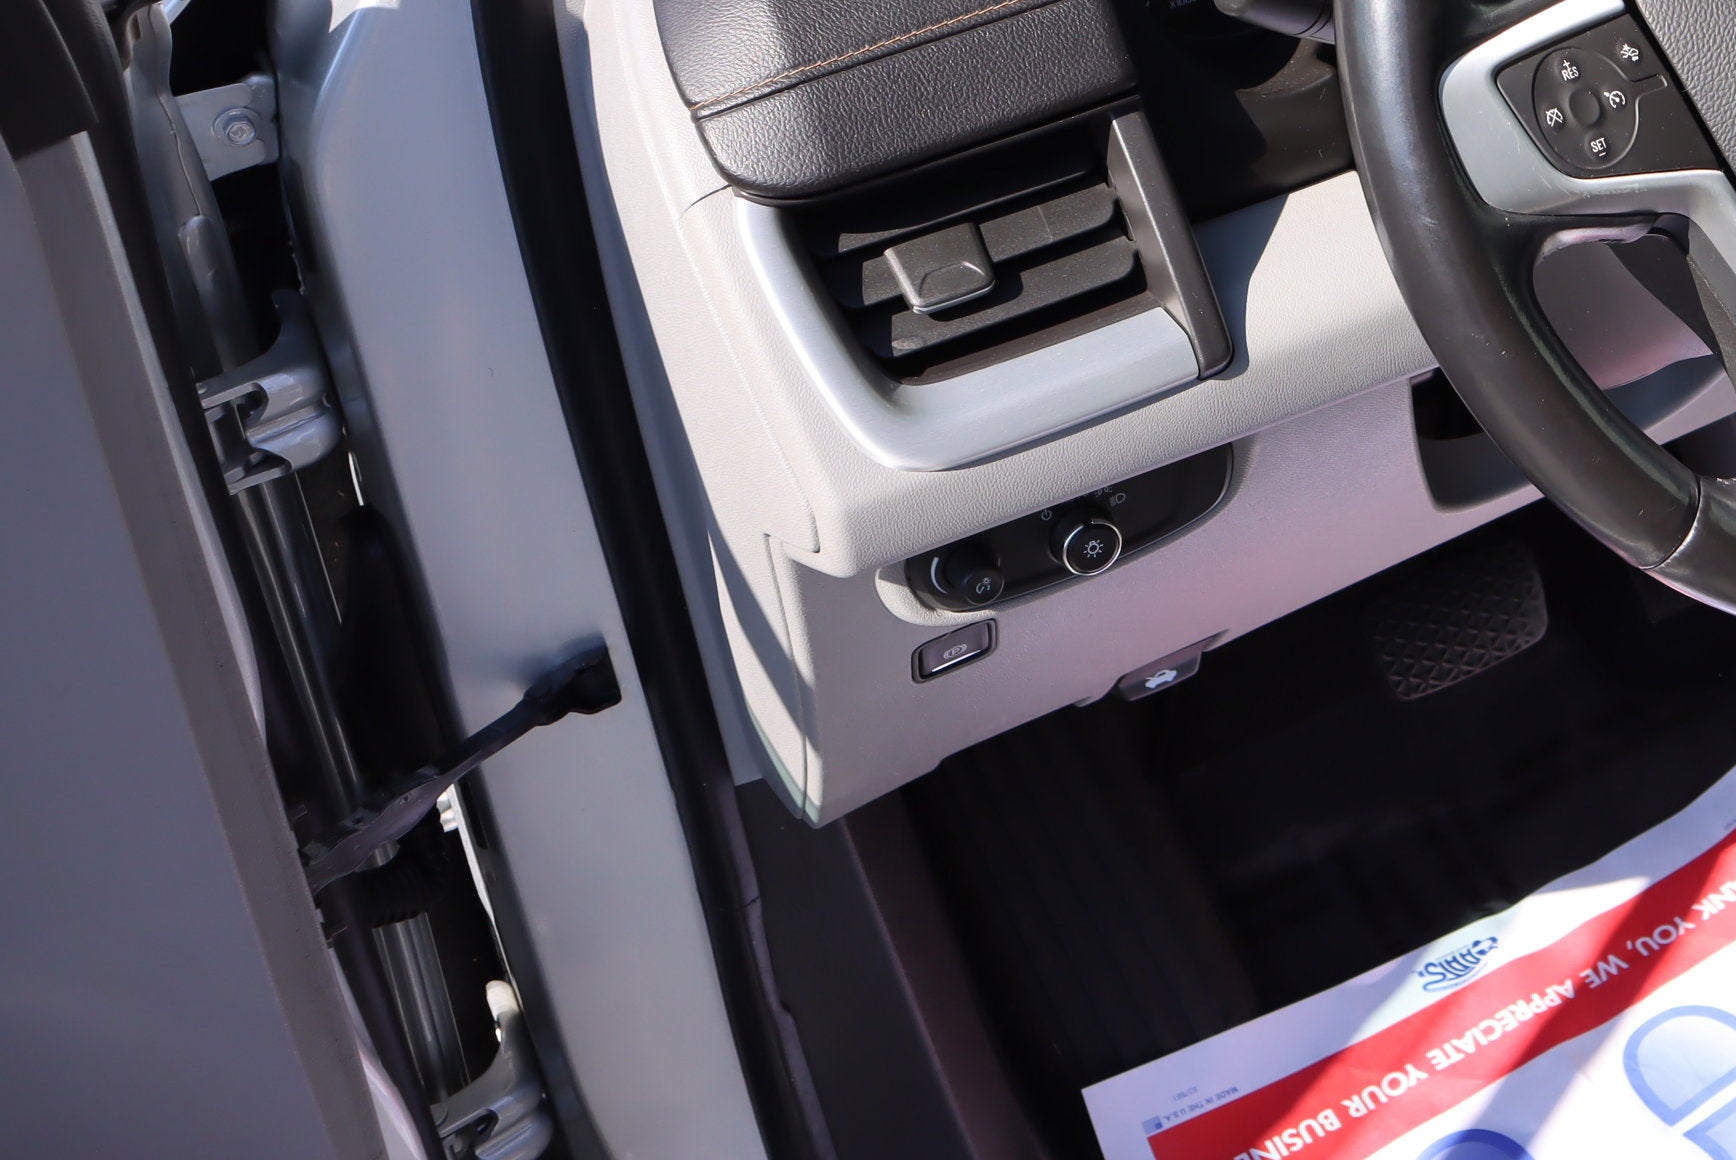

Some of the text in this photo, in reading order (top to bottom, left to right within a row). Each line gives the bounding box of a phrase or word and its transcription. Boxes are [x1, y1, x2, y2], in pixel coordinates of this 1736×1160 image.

[1561, 66, 1579, 81] RES
[1590, 138, 1607, 152] SET
[1626, 915, 1697, 959] YOU,
[1582, 953, 1630, 990] WE
[1429, 978, 1576, 1073] APPRECIATE
[1215, 1087, 1238, 1102] MADE
[1341, 1063, 1431, 1121] YOUR
[1189, 1101, 1204, 1113] THE
[1205, 1096, 1214, 1106] IN
